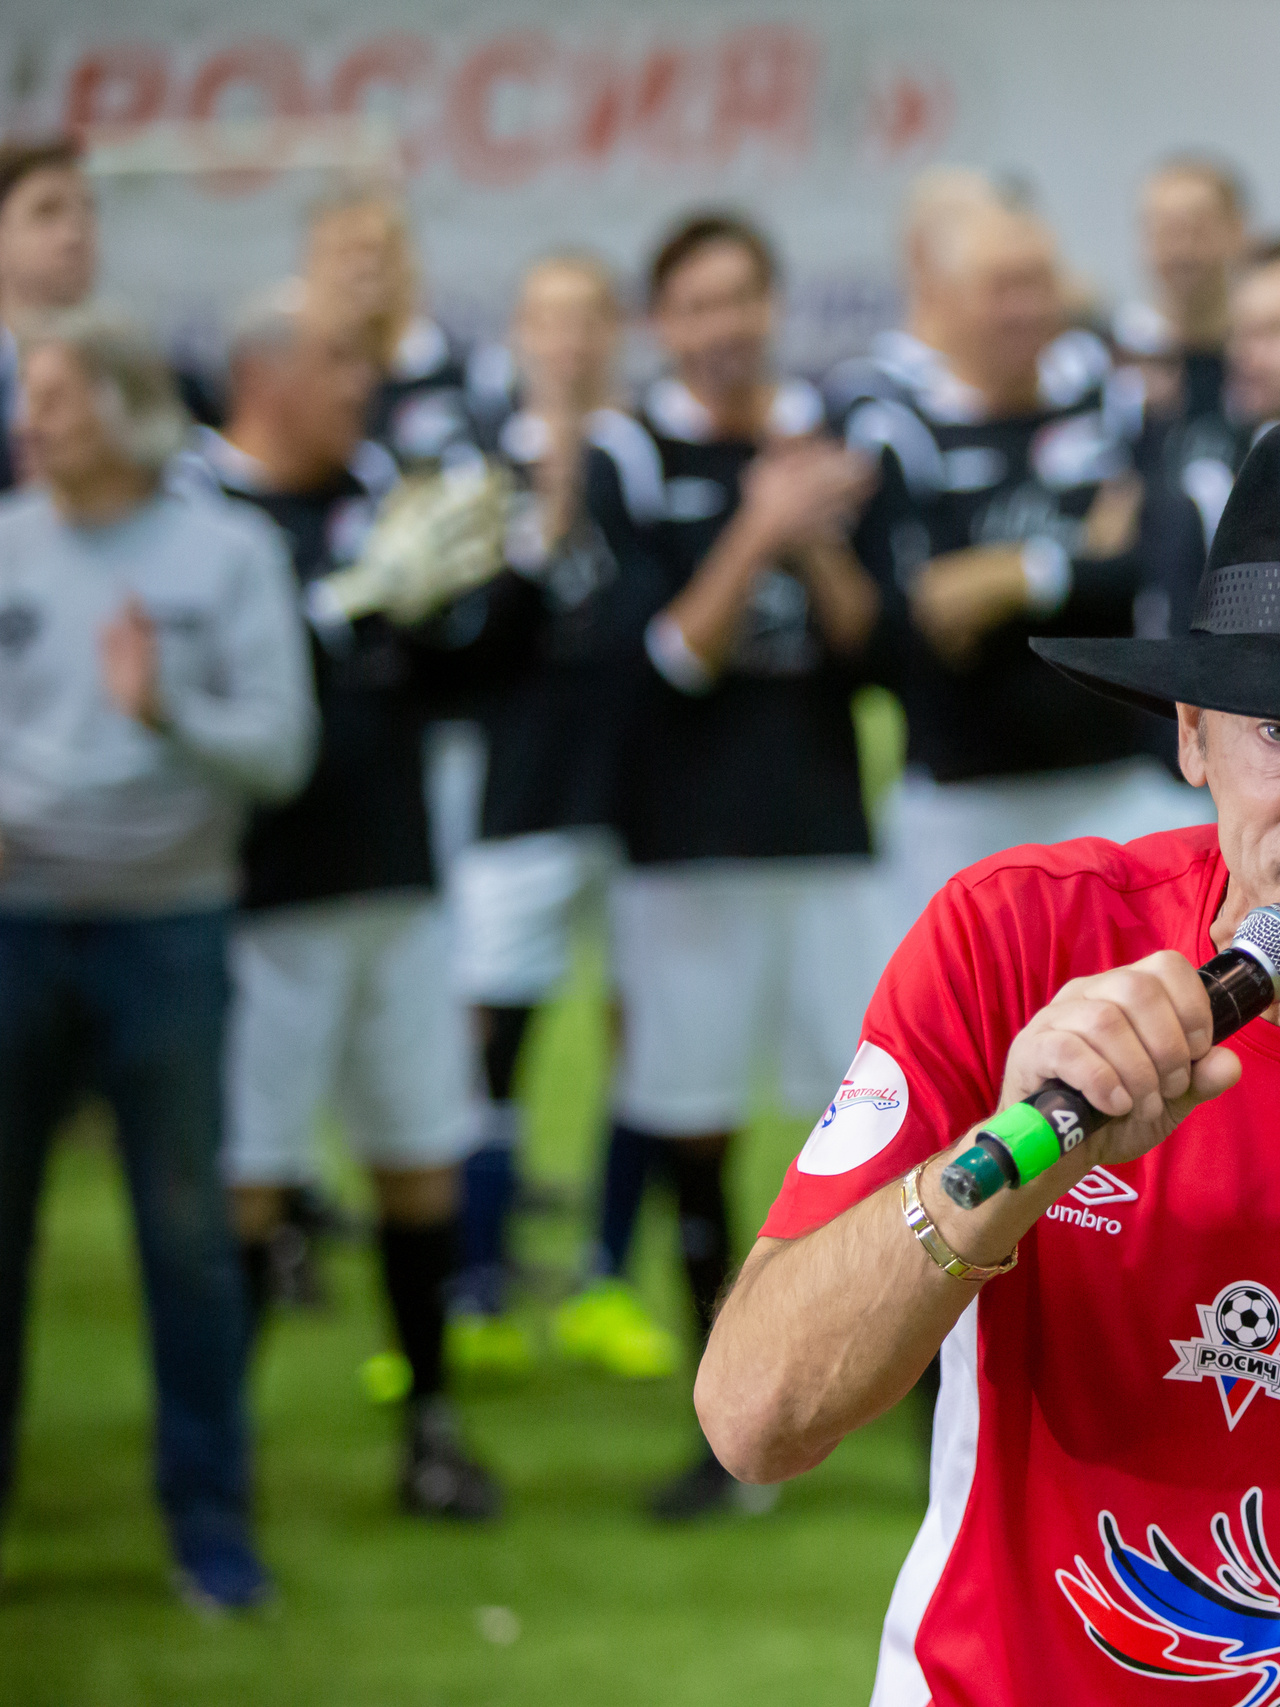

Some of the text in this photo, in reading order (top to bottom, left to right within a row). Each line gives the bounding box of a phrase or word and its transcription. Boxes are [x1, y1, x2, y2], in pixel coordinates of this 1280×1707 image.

[839, 1087, 898, 1102] FOOTBALL
[1052, 1109, 1084, 1152] 46
[1046, 1204, 1122, 1235] umbro
[1200, 1349, 1277, 1380] РОСИЧ
